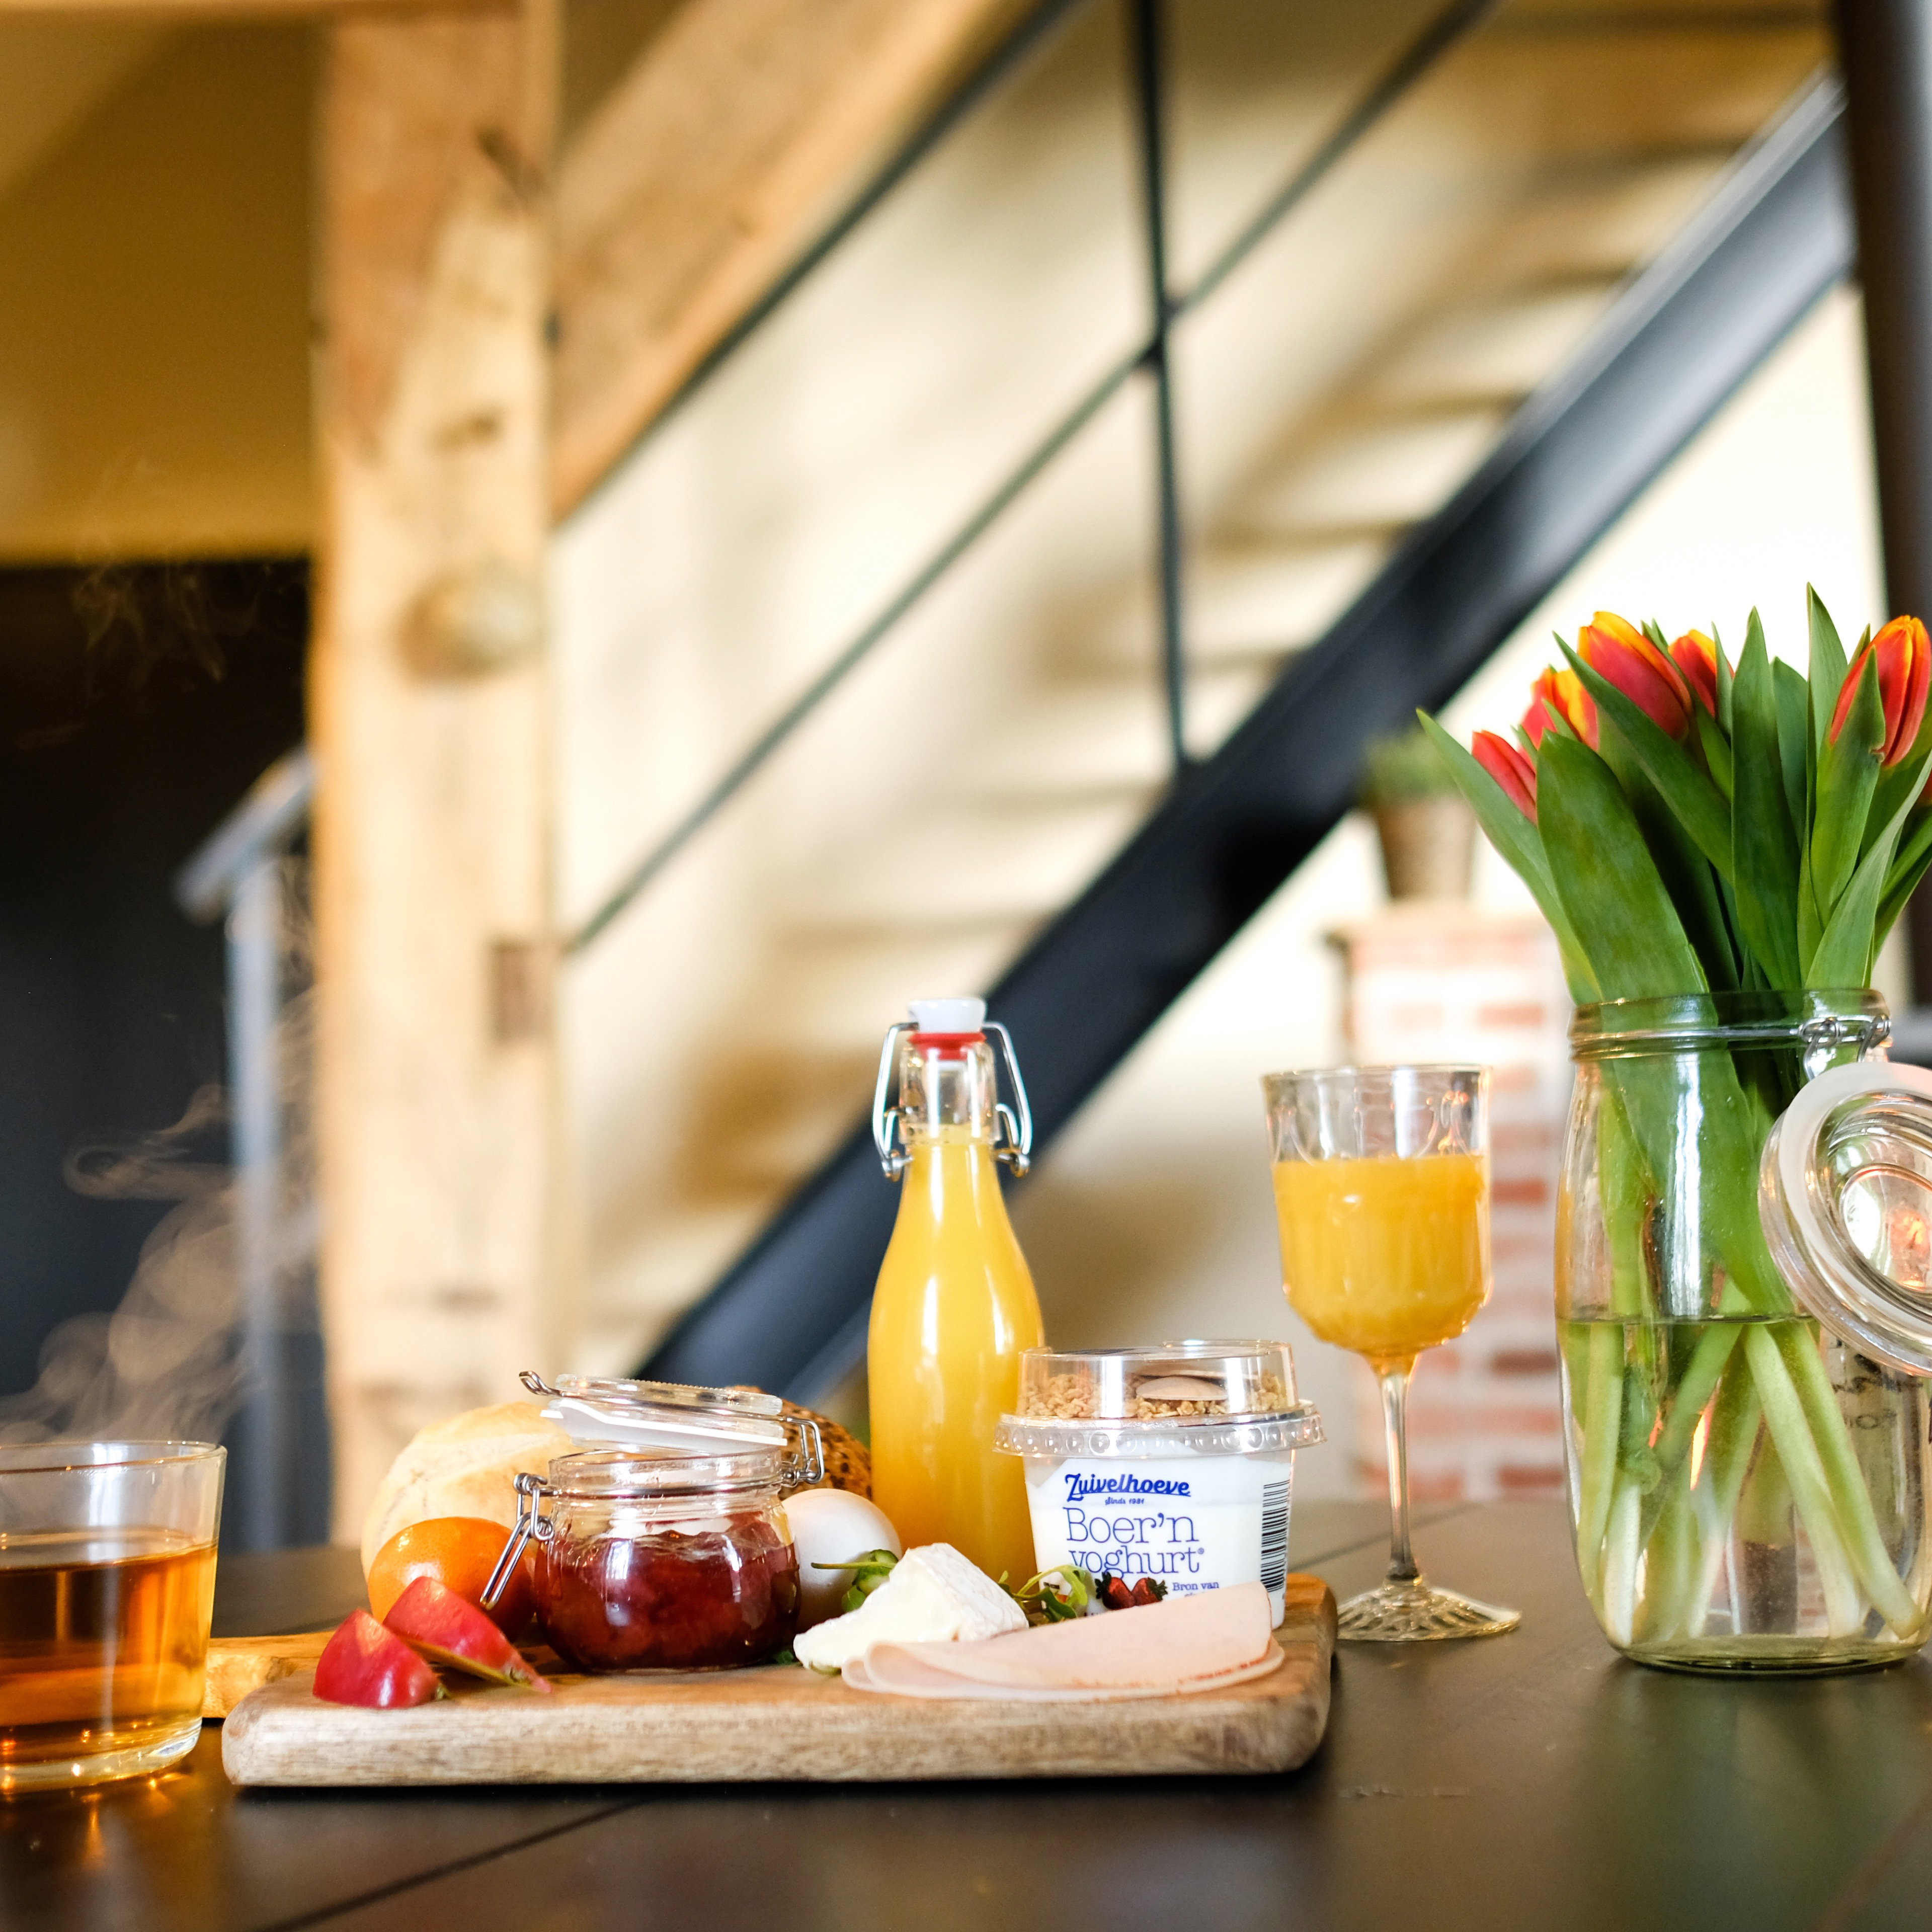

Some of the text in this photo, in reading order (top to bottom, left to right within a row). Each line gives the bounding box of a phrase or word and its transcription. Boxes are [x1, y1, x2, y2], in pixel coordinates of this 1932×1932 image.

[1065, 1473, 1191, 1502] Zuivelhoeve
[1062, 1507, 1199, 1544] Boer'n
[1172, 1582, 1198, 1591] Bron
